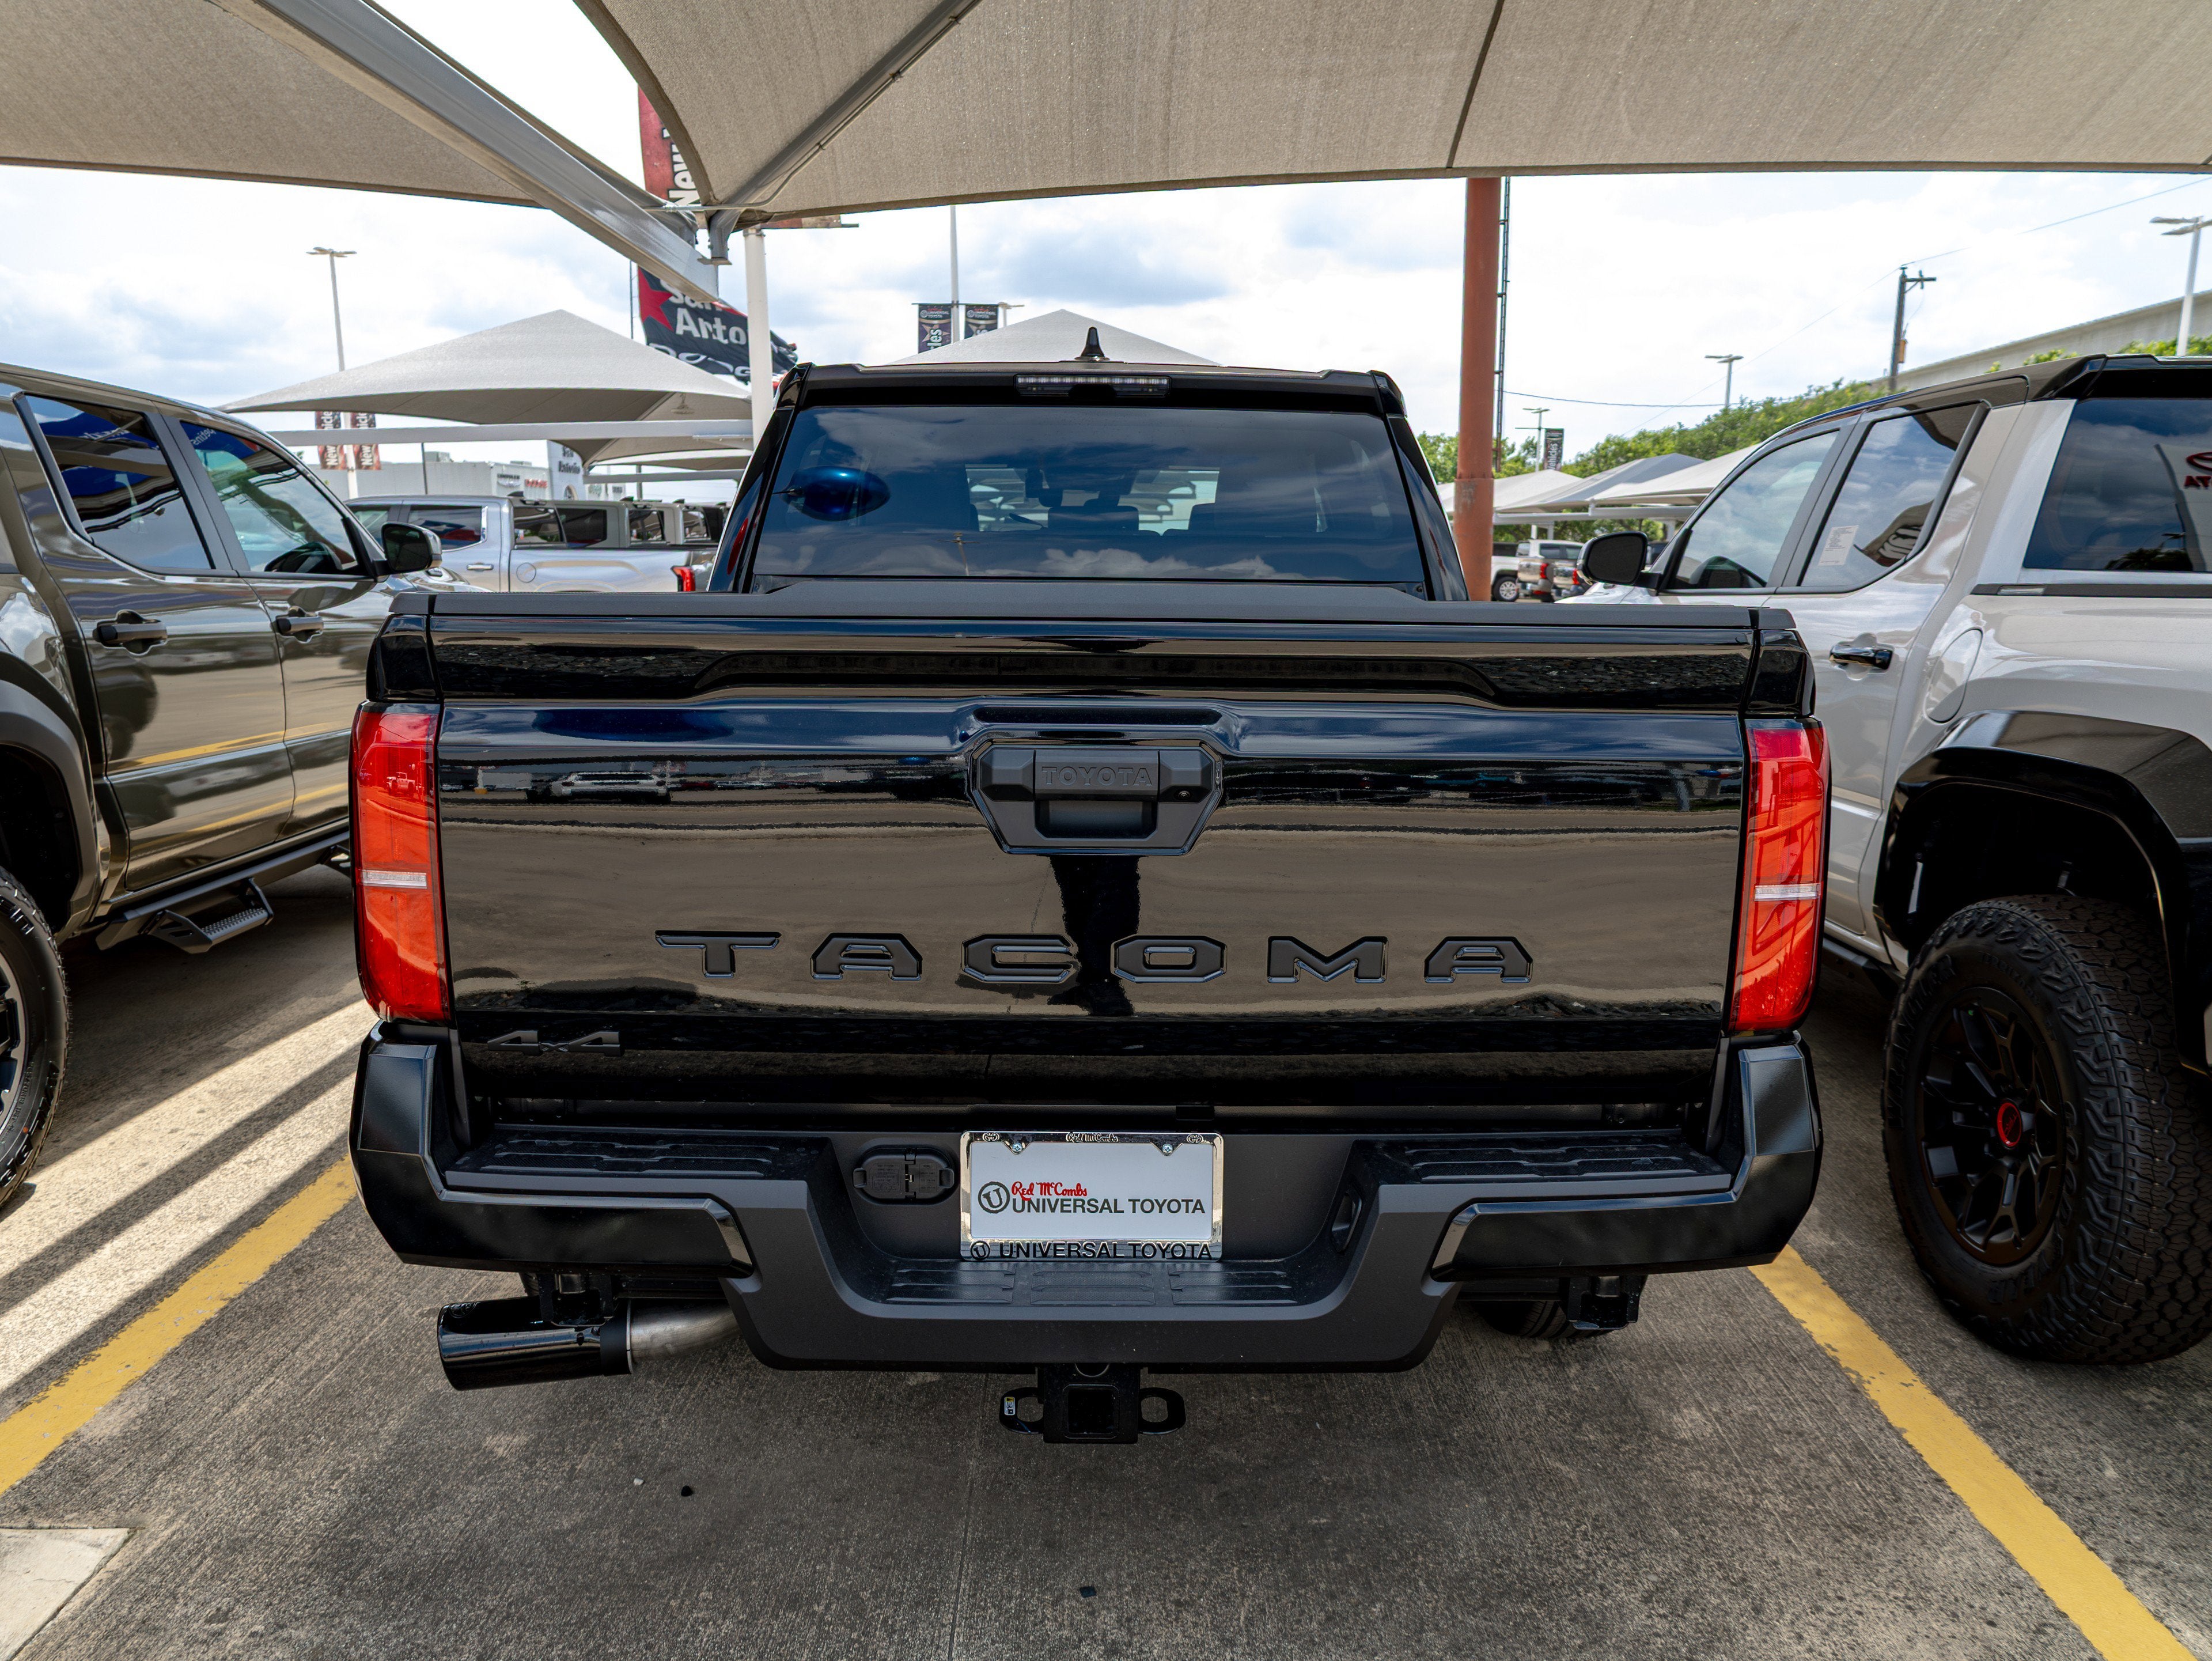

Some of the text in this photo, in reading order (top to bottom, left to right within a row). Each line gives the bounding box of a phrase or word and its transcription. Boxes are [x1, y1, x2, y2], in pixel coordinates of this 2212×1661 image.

[1041, 766, 1153, 786] TOYOTA
[654, 930, 1534, 984] TACOMA
[487, 1029, 622, 1057] 4x4
[1012, 1181, 1088, 1201] Red McCombs
[1012, 1198, 1206, 1214] UNIVERSAL TOYOTA
[999, 1241, 1213, 1260] UNIVERSAL TOYOTA
